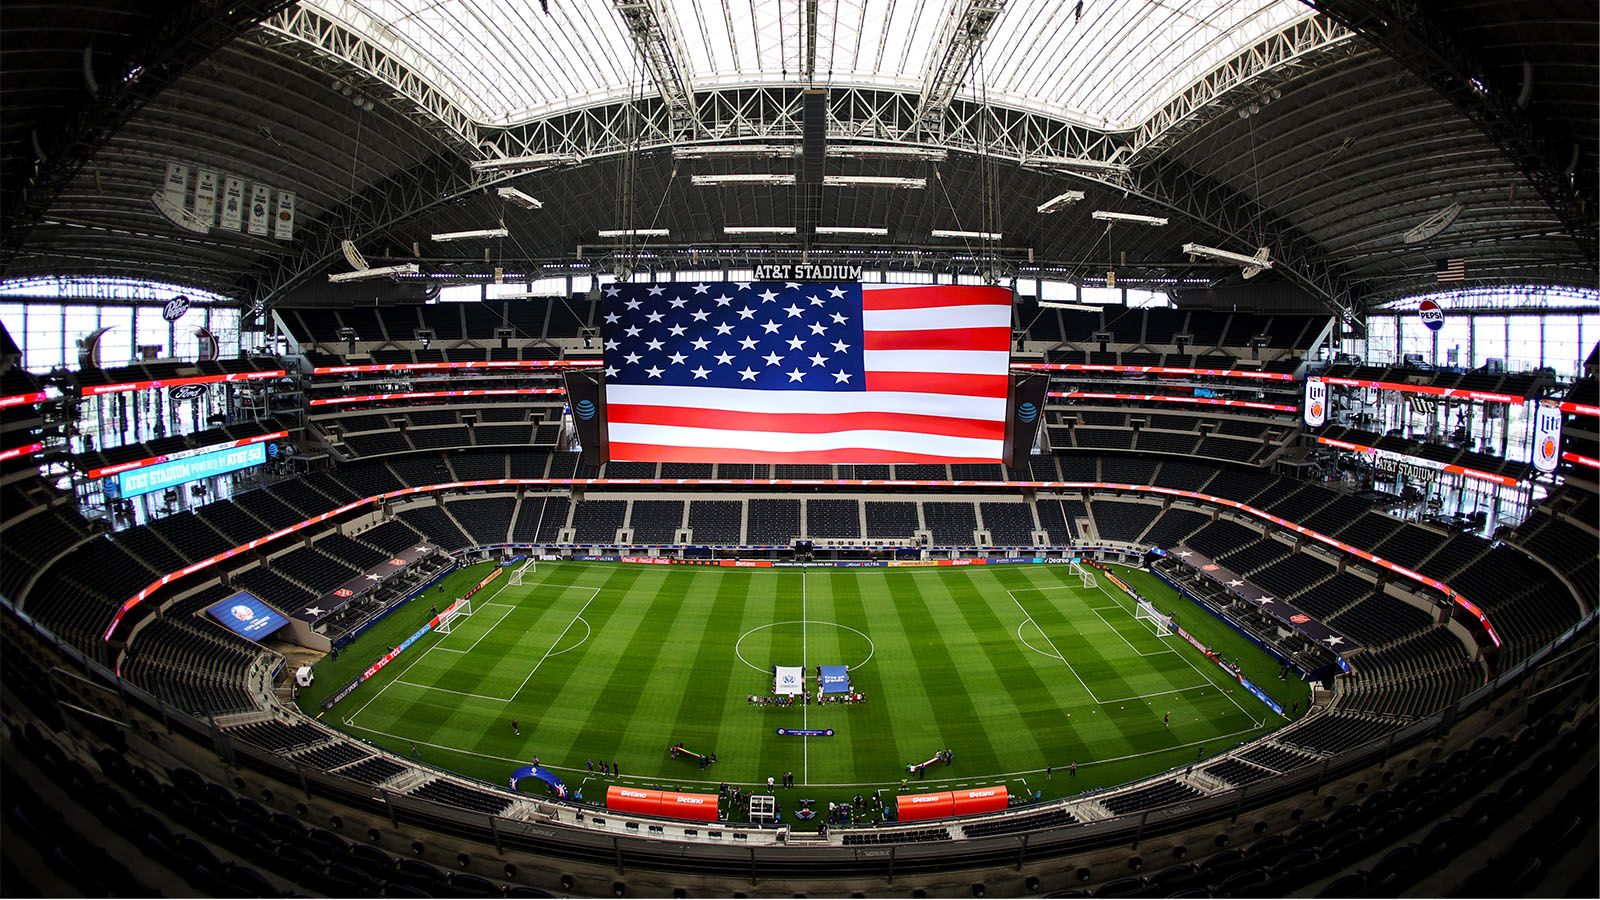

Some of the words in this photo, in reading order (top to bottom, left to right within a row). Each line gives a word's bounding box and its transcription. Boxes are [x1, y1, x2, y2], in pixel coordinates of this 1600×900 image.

[755, 265, 792, 279] AT&T
[795, 265, 863, 280] STADIUM
[164, 301, 189, 319] Pepper
[175, 299, 185, 308] Dr
[175, 386, 202, 399] Ford
[1310, 386, 1326, 400] Lite
[1409, 396, 1436, 416] Lite
[1541, 414, 1560, 434] Lite
[125, 473, 149, 492] AT&T
[149, 463, 190, 486] STADIUM
[191, 459, 218, 473] POWERED
[227, 452, 248, 467] AT&T
[1378, 459, 1398, 472] AT&T
[1398, 462, 1436, 482] STADIUM
[364, 668, 376, 679] TCL
[378, 659, 389, 669] TCL
[390, 648, 400, 659] TCL
[620, 790, 647, 799] Betano
[676, 796, 704, 805] Betano
[912, 796, 939, 804] Betano
[969, 790, 995, 799] Betano
